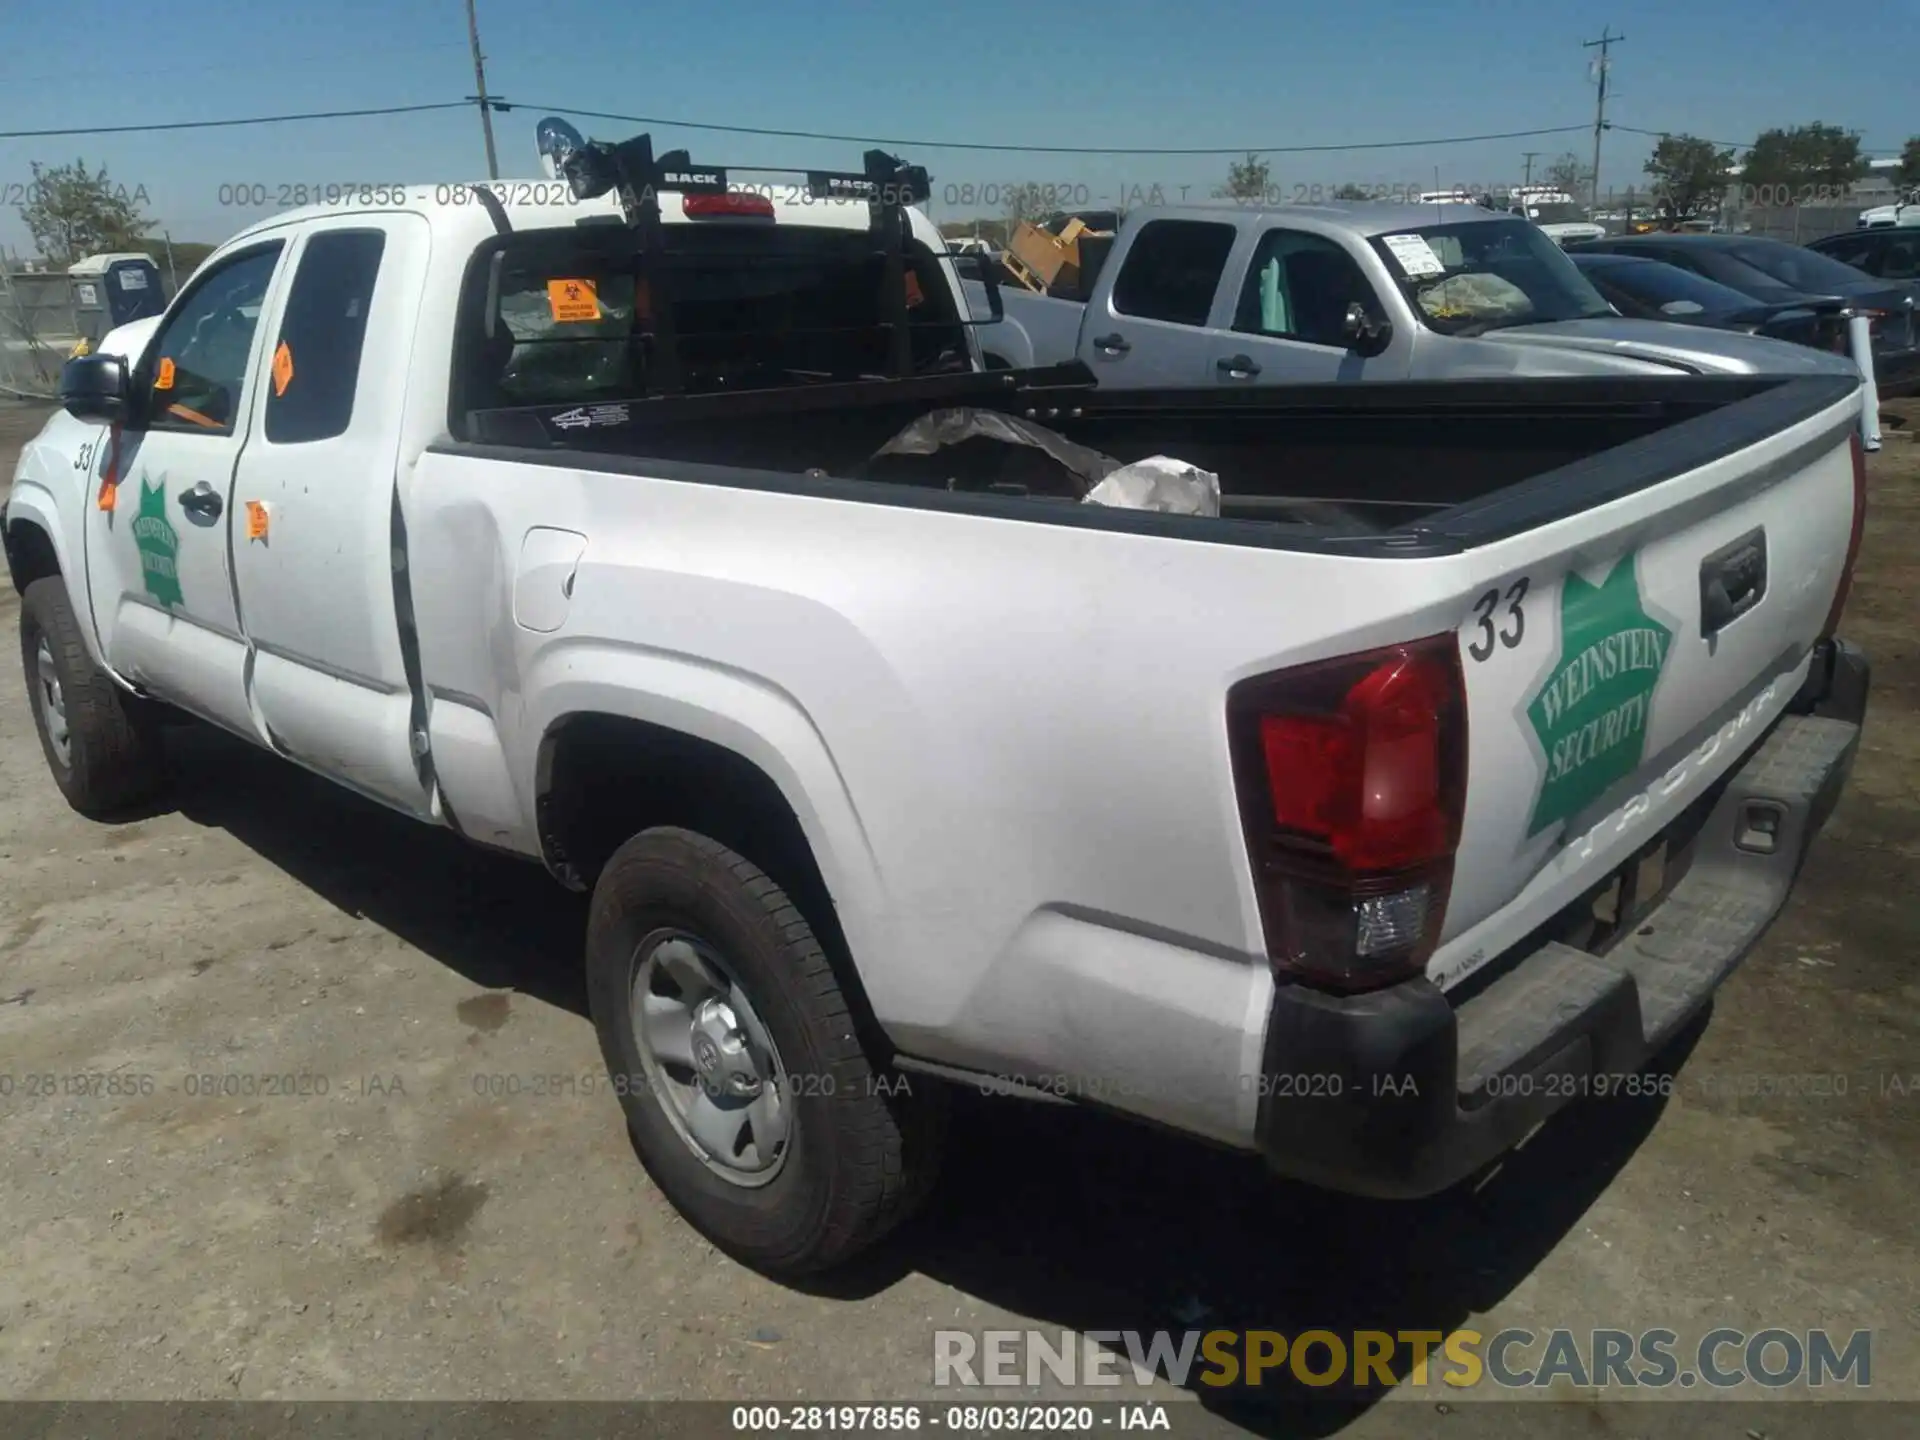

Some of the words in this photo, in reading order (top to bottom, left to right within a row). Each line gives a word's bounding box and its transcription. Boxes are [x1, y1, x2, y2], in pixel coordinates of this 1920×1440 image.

[74, 443, 93, 471] 33
[1468, 576, 1531, 662] 33
[1541, 628, 1665, 730] WEINSTEIN
[1548, 690, 1652, 784] SECURITY
